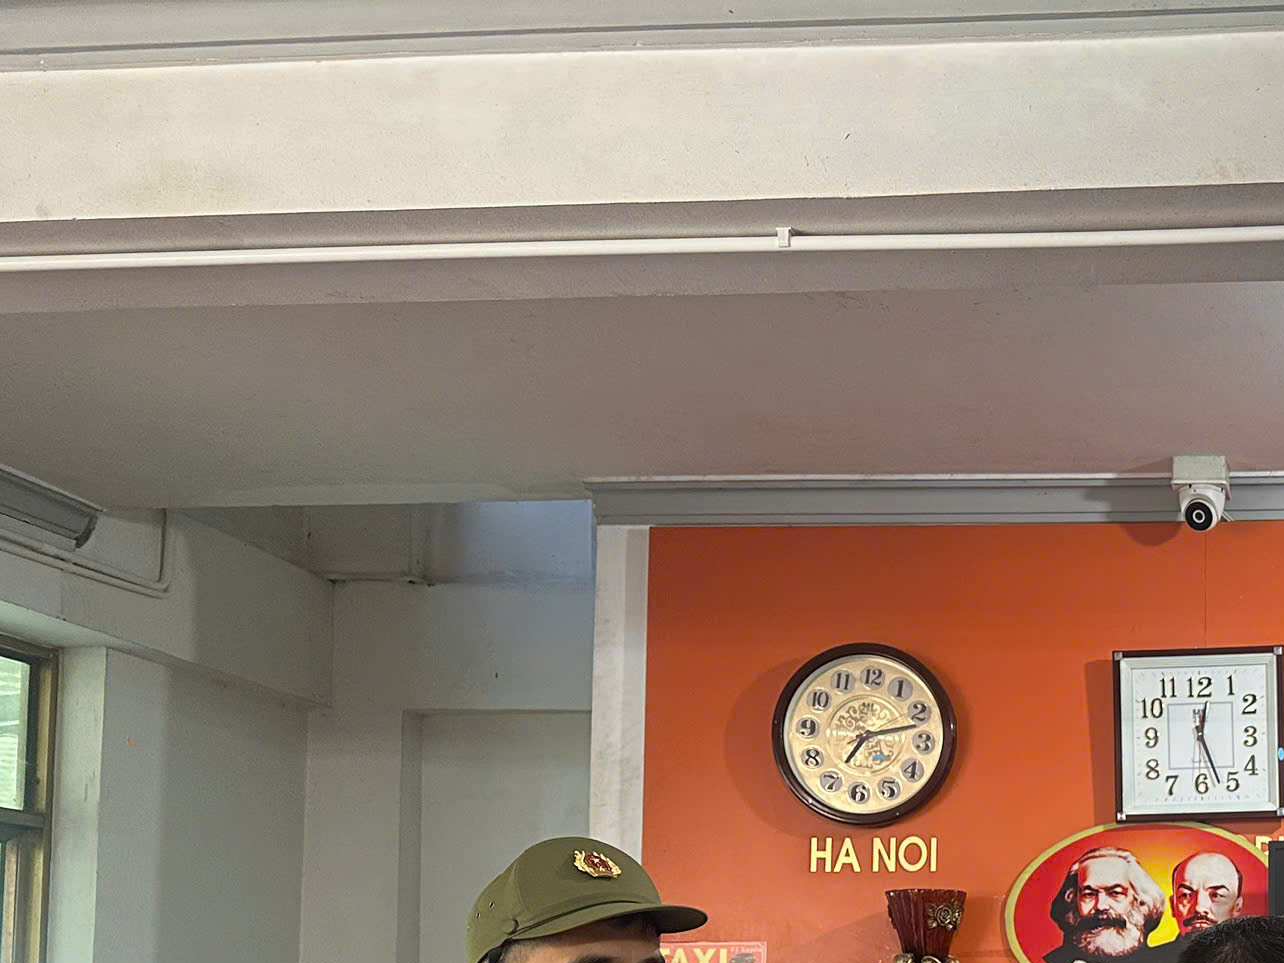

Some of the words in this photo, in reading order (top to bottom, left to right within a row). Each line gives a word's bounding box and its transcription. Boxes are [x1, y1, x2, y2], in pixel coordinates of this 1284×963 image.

[834, 672, 850, 690] 11
[864, 668, 882, 685] 12
[1228, 675, 1234, 695] 1
[895, 681, 904, 698] 1
[1160, 677, 1176, 698] 11
[1187, 677, 1212, 697] 12
[812, 691, 828, 707] 10
[1142, 698, 1163, 718] 10
[1242, 694, 1257, 715] 2
[913, 704, 926, 722] 2
[801, 719, 814, 735] 9
[1244, 726, 1257, 747] 3
[917, 734, 931, 752] 3
[1145, 728, 1159, 748] 9
[805, 750, 820, 767] 8
[1244, 755, 1258, 775] 4
[904, 762, 917, 779] 4
[1146, 759, 1160, 779] 8
[824, 775, 840, 791] 7
[882, 780, 895, 798] 5
[1166, 776, 1178, 796] 7
[1195, 774, 1209, 794] 6
[1226, 772, 1240, 792] 5
[852, 785, 866, 801] 6
[810, 837, 860, 872] HA
[873, 836, 937, 872] NOI
